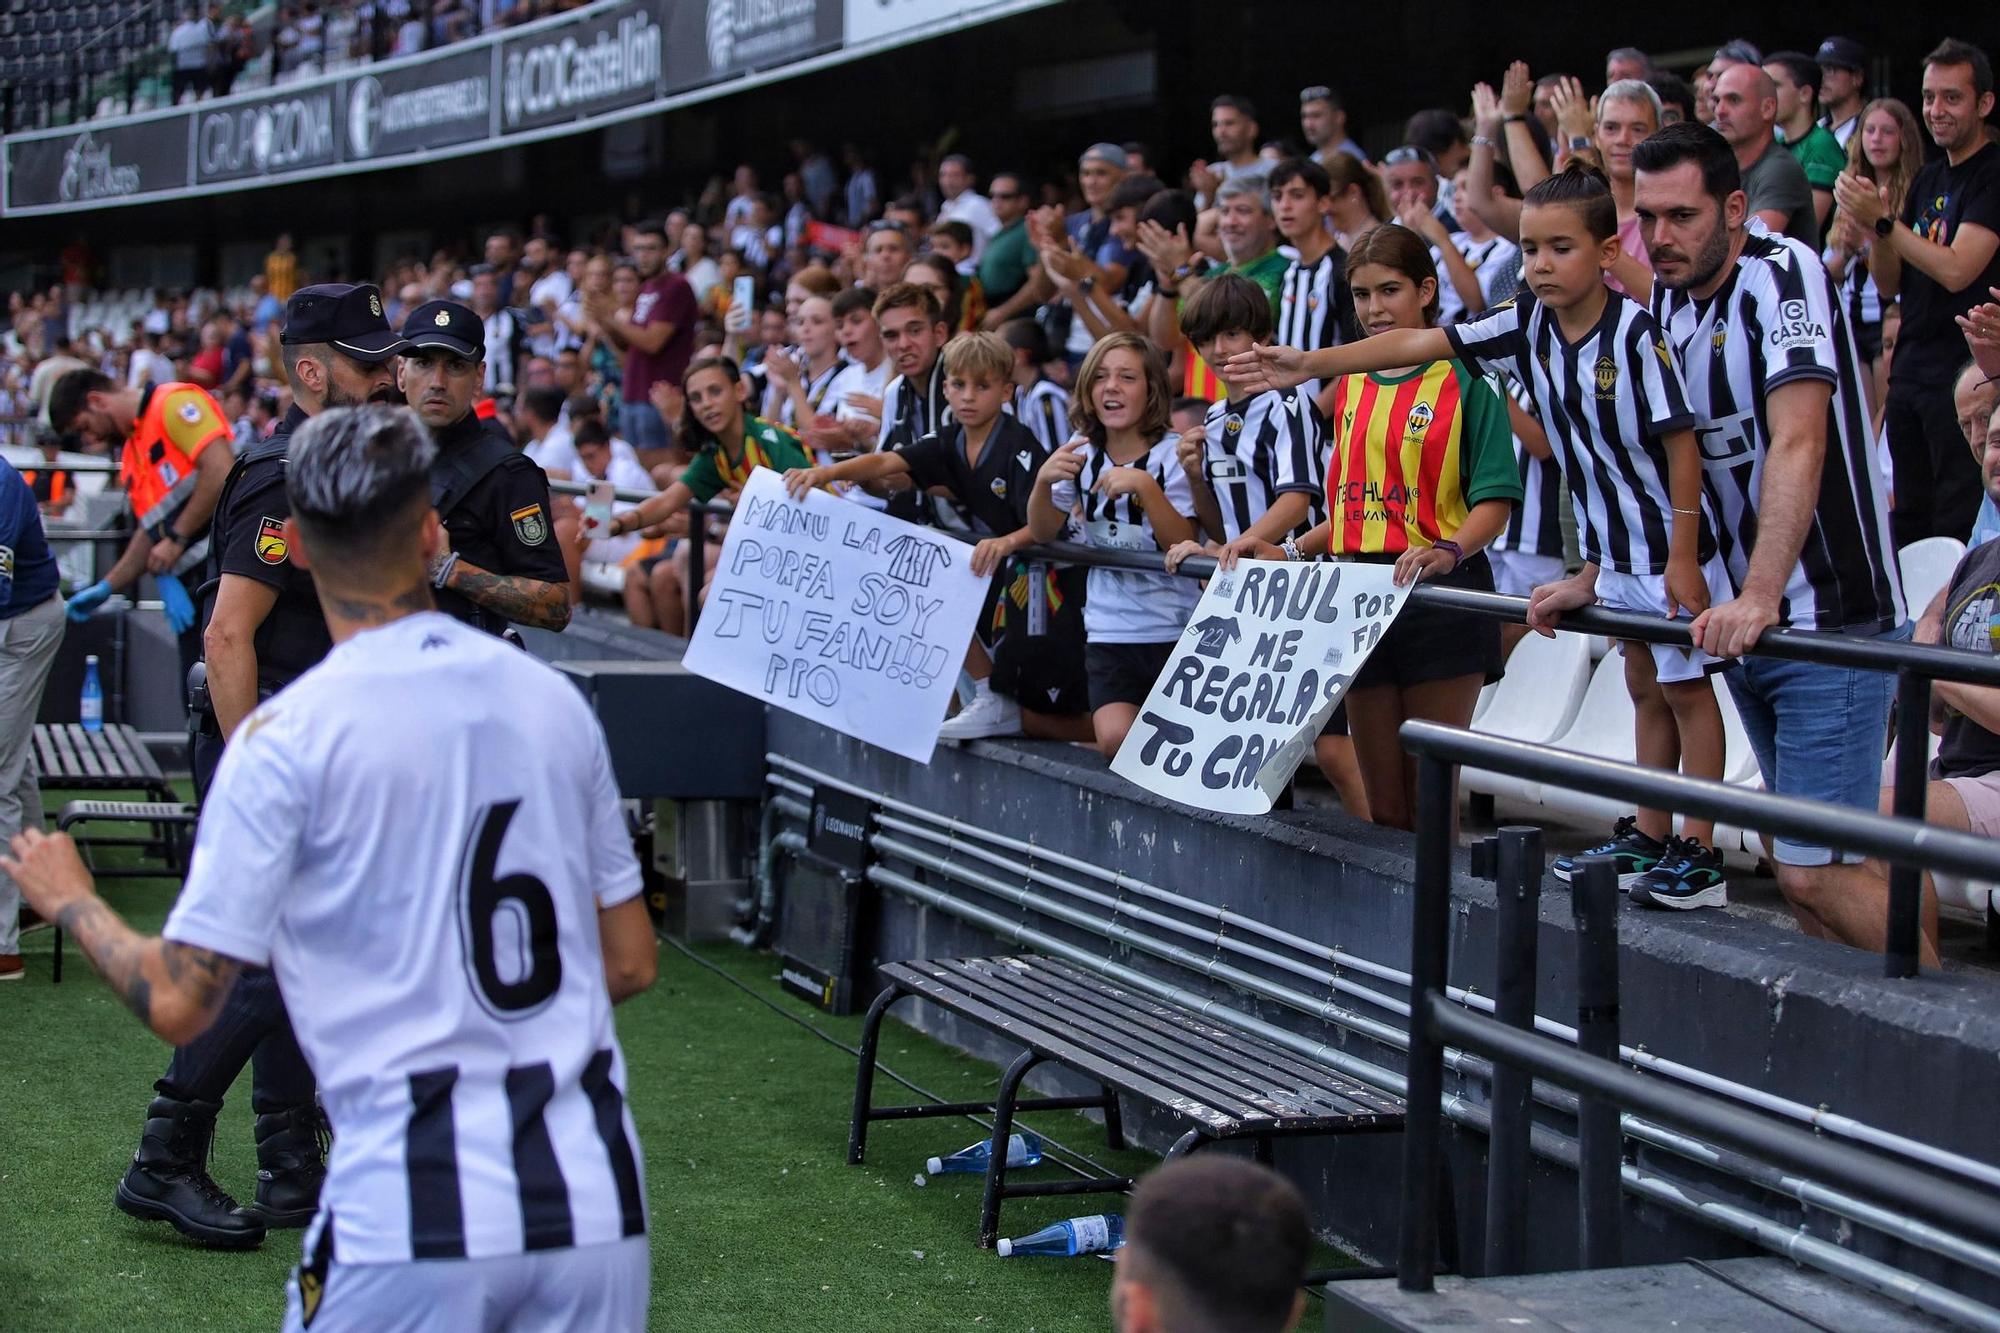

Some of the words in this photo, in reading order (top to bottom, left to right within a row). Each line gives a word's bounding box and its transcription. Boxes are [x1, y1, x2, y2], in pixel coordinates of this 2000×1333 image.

[1770, 321, 1827, 346] CASVA
[1781, 338, 1815, 349] Seguridad
[744, 496, 829, 541] MANU
[842, 522, 881, 554] LA
[731, 539, 834, 600] PORFA
[851, 572, 943, 638] SOY
[1234, 563, 1340, 624] RAÚL
[1352, 592, 1395, 619] POR
[714, 588, 789, 644] TU
[795, 610, 949, 689] FAN!!!
[1199, 628, 1224, 648] 22
[1248, 629, 1303, 672] ME
[1351, 621, 1382, 654] FA
[457, 796, 562, 1023] 6
